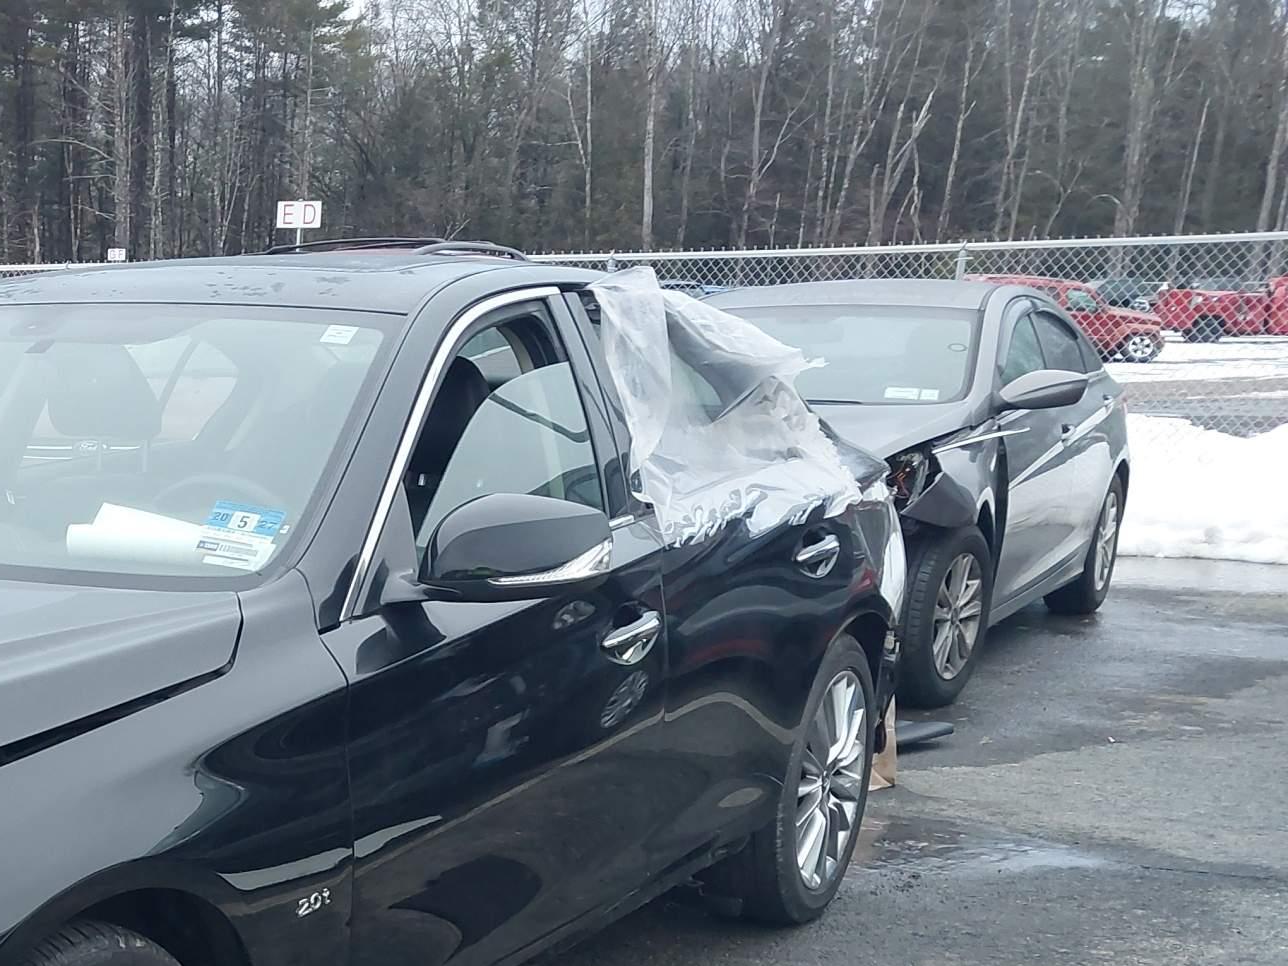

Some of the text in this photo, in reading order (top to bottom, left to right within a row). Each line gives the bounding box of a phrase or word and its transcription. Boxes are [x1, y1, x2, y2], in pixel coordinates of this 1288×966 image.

[213, 511, 278, 530] 20 5 27
